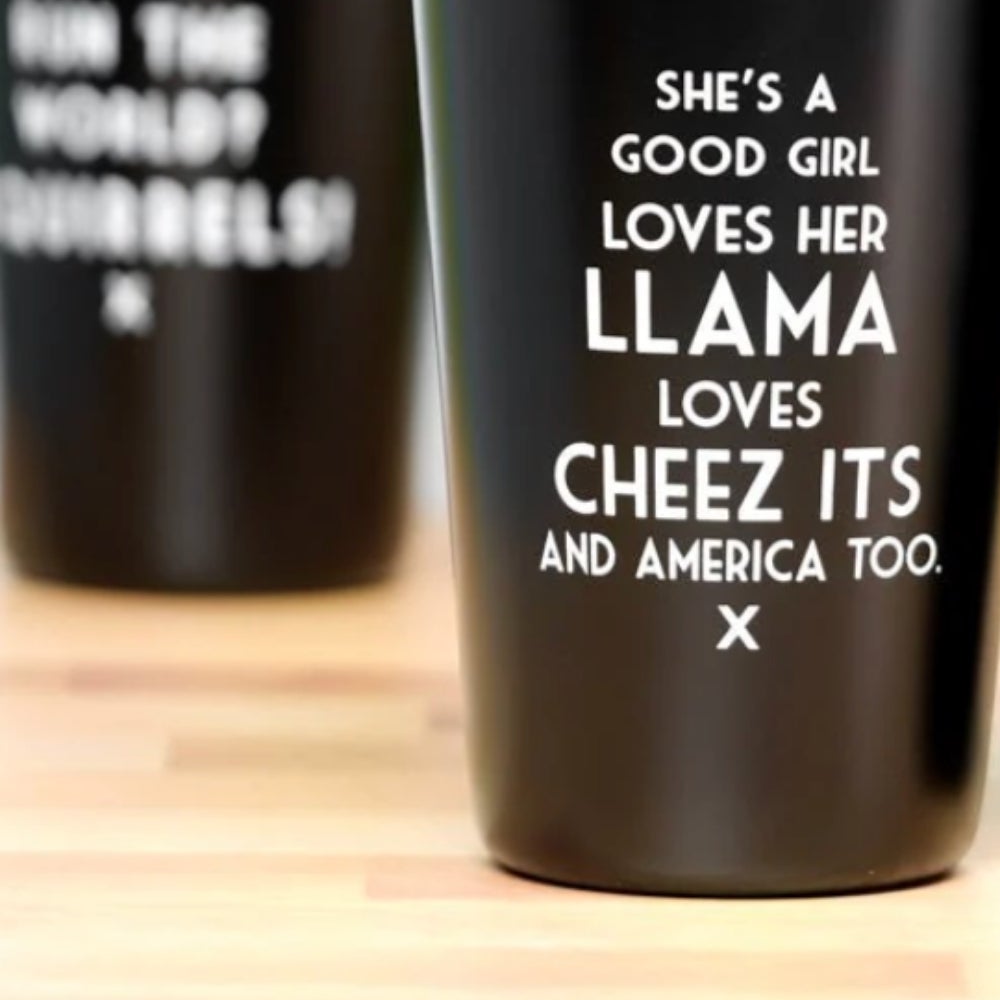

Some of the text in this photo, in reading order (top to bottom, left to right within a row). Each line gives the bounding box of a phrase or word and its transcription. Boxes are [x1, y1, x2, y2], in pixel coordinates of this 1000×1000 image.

[656, 69, 836, 112] SHE'S A
[611, 134, 880, 177] GOOD GIRL
[602, 202, 888, 254] LOVES HER
[586, 268, 897, 356] LLAMA
[658, 380, 822, 429] LOVES
[554, 443, 920, 522] CHEEZ ITS
[540, 530, 942, 583] AND AMERICA TOO.
